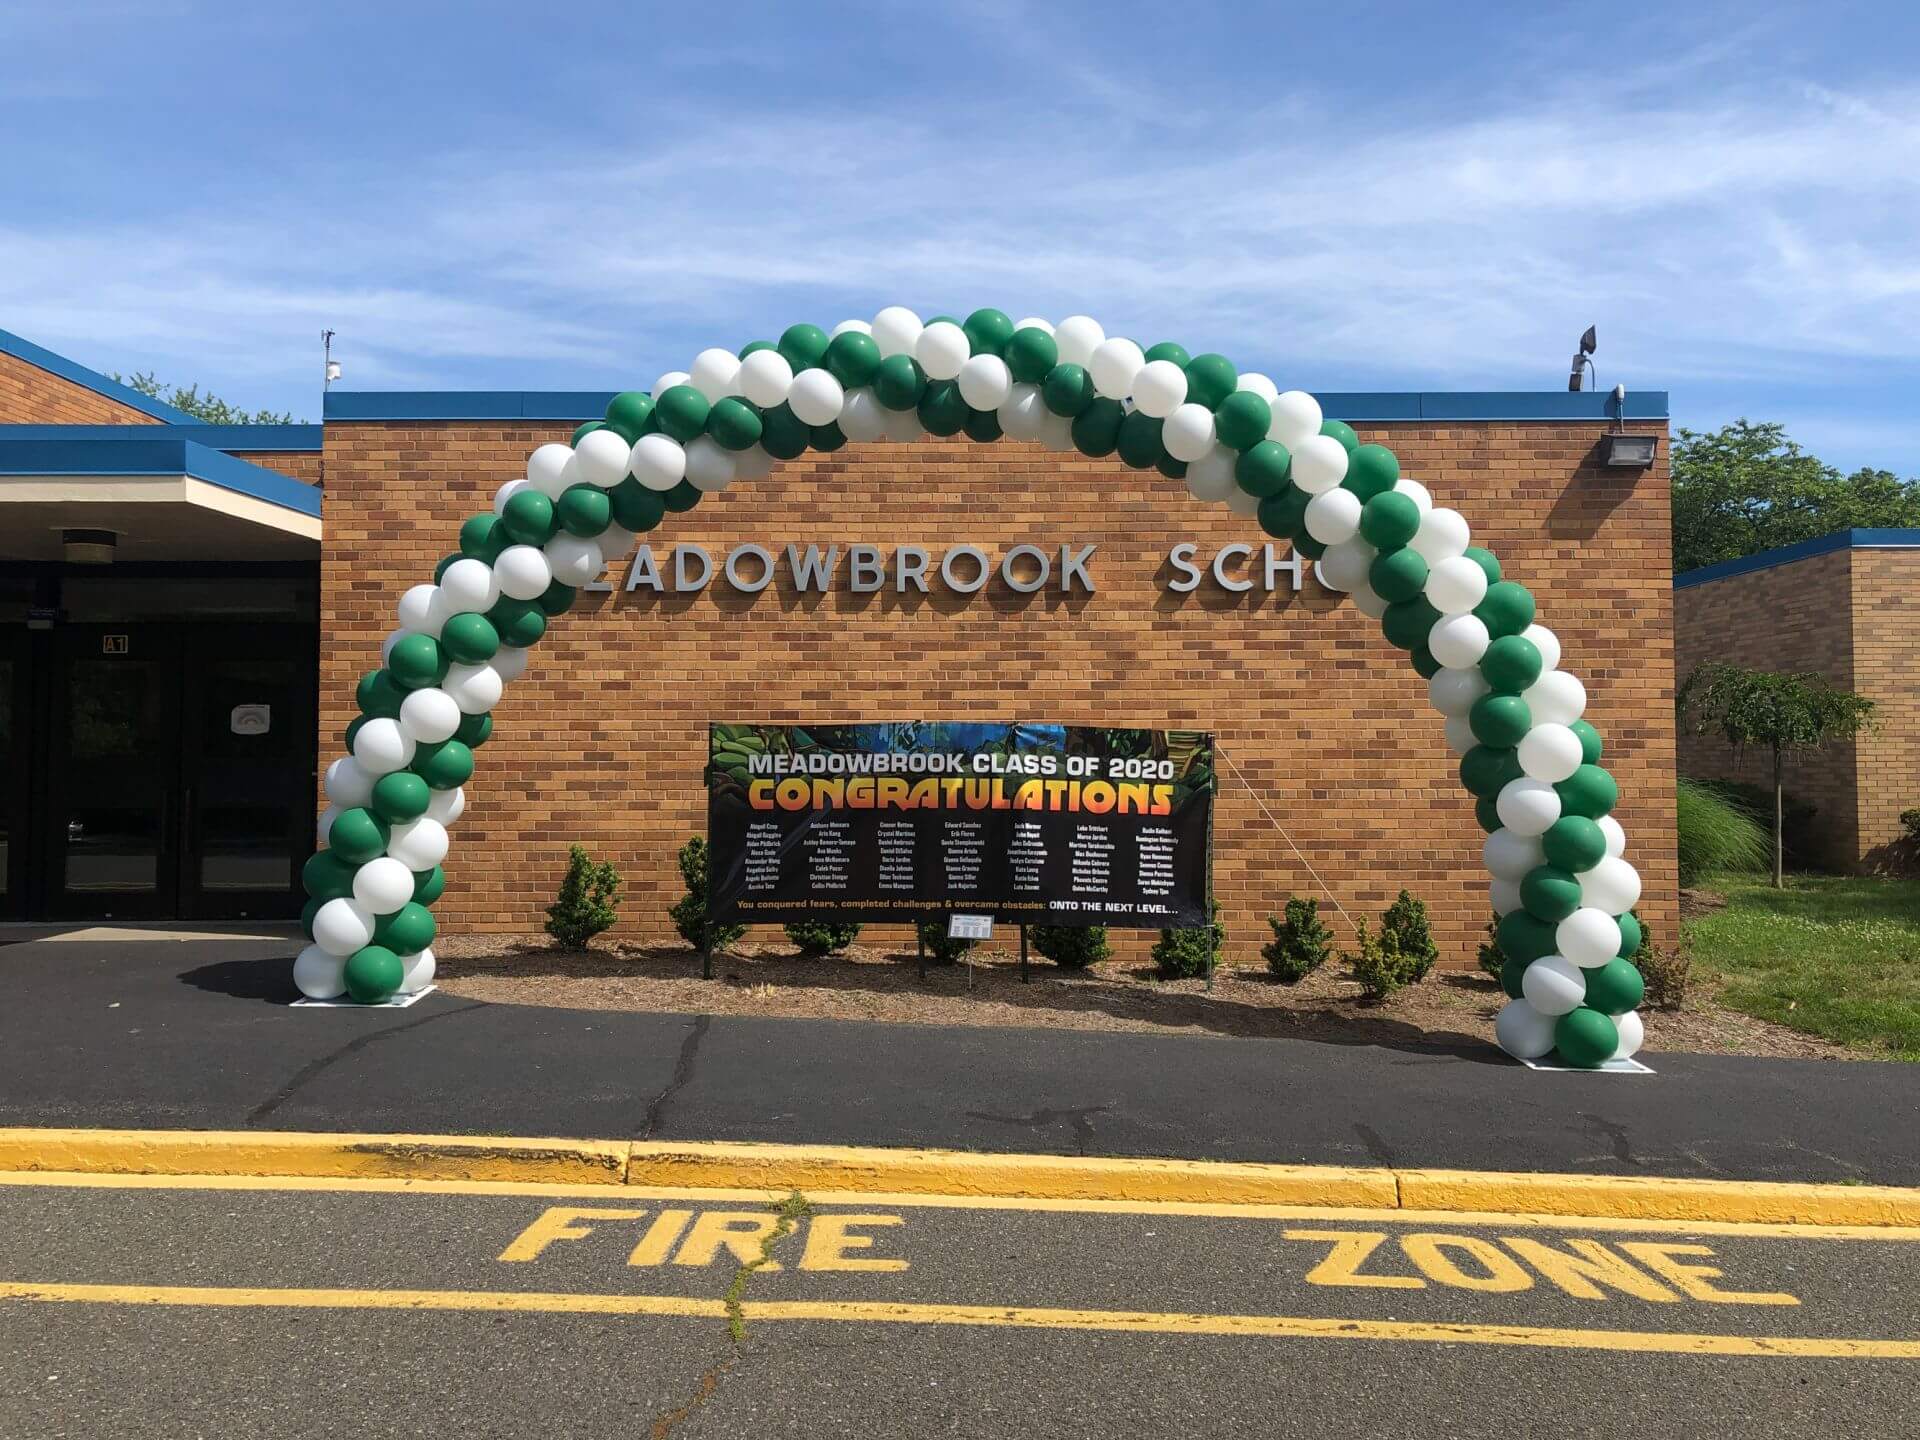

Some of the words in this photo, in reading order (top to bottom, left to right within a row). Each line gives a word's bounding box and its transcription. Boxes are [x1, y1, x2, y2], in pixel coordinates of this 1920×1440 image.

[105, 638, 125, 652] A1
[748, 752, 964, 775] MEADOWBROOK
[973, 754, 1057, 775] CLASS
[1066, 755, 1099, 777] OF
[1109, 757, 1174, 780] 2020
[748, 778, 1175, 816] CONGRATULATIONS
[737, 900, 754, 909] You
[757, 900, 807, 910] conquered
[810, 900, 838, 909] fears,
[841, 900, 889, 910] completed
[893, 900, 941, 910] challenges
[944, 900, 952, 908] &
[1049, 901, 1079, 910] ONTO
[1081, 902, 1102, 911] THE
[1105, 902, 1134, 913] NEXT
[1136, 904, 1178, 914] LEVEL...
[496, 1207, 910, 1273] FIRE
[1282, 1230, 1802, 1305] ZONE
